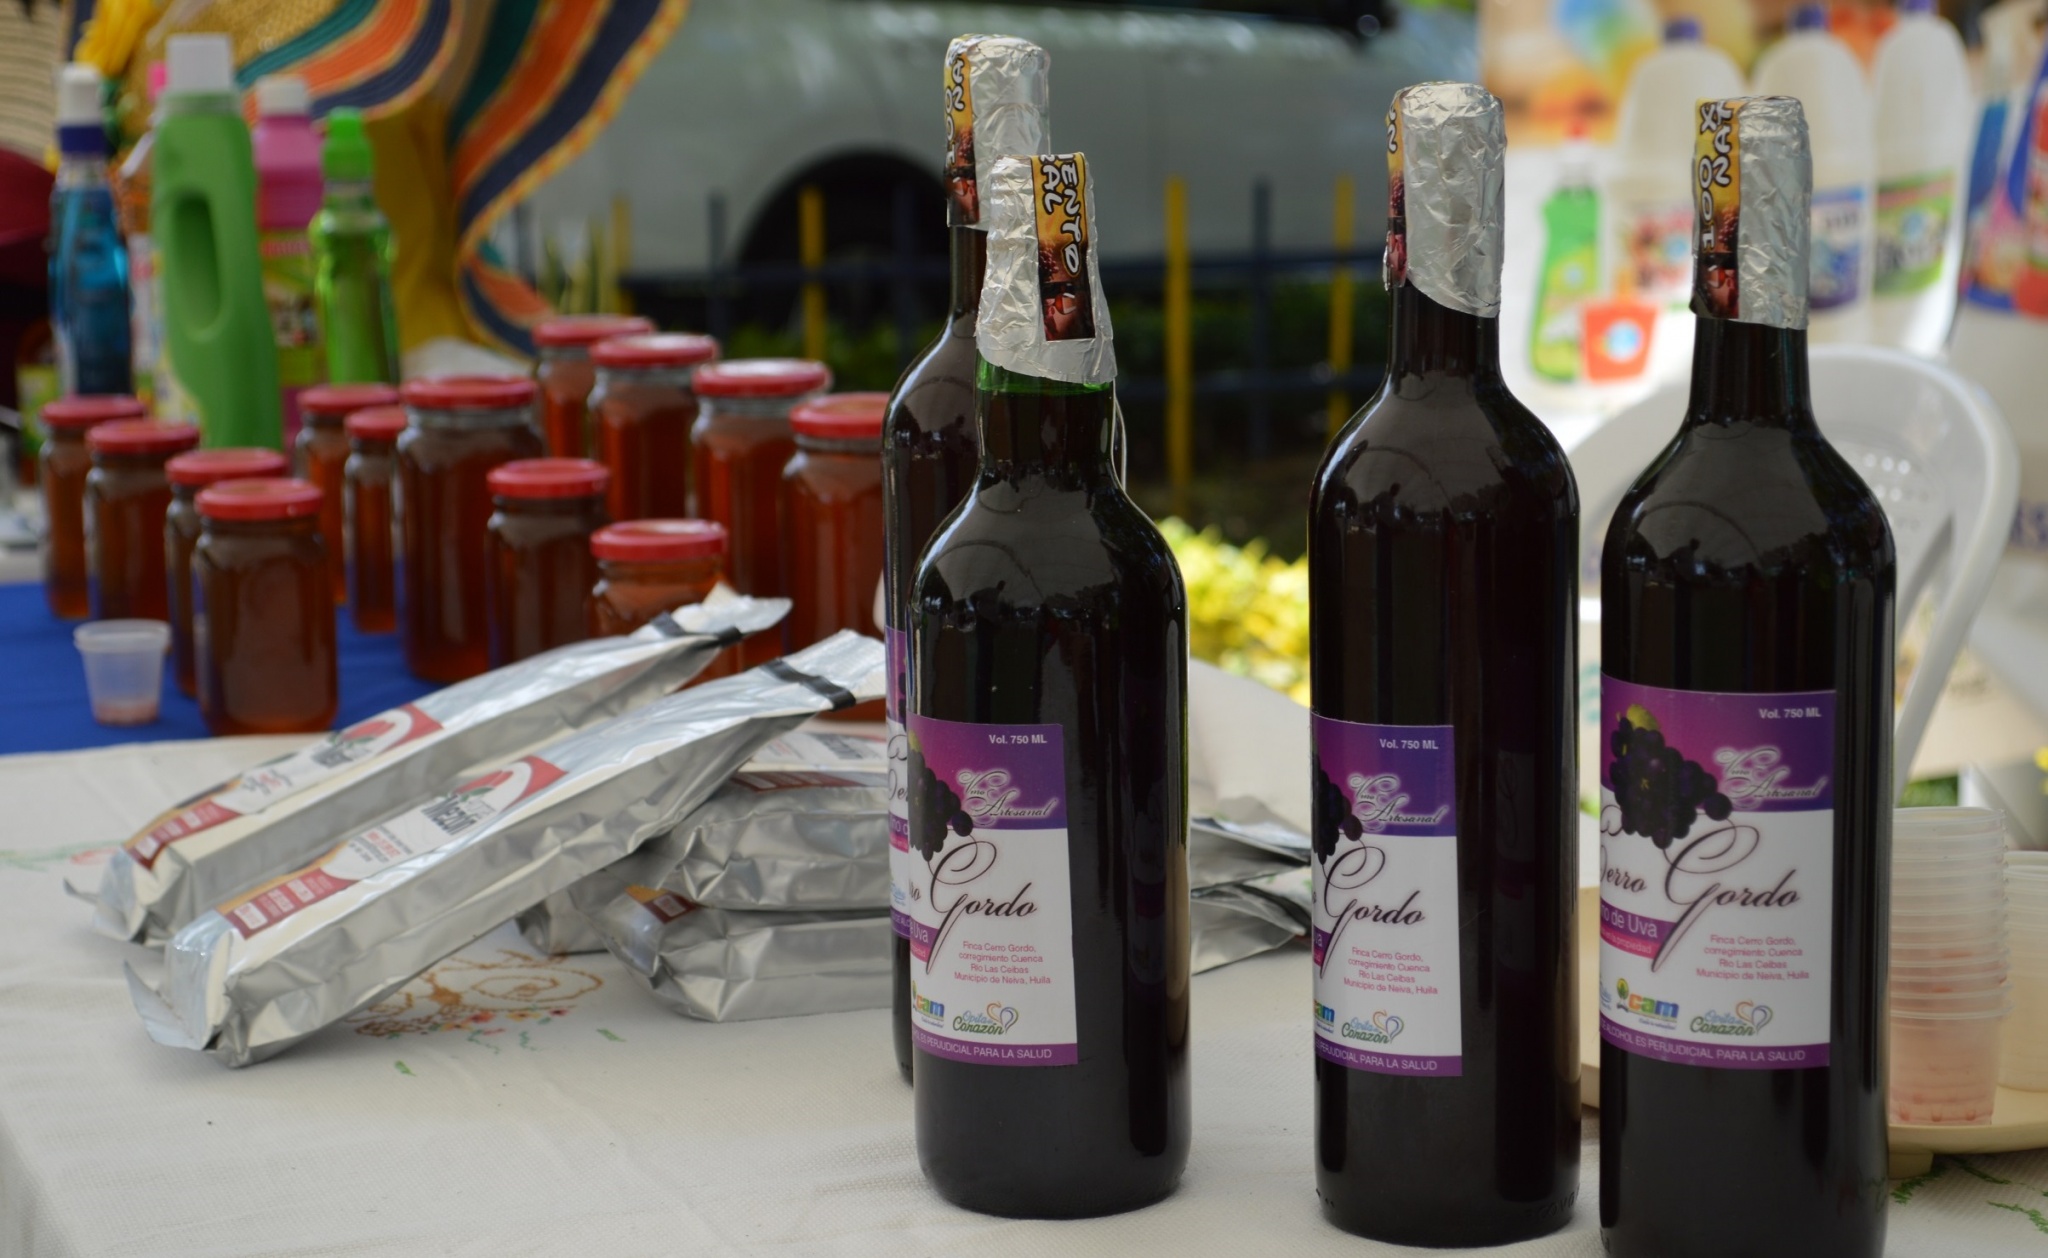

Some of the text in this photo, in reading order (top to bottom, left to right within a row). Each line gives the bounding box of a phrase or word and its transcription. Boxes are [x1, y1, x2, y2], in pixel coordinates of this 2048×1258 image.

[1057, 152, 1082, 276] IENTO
[1758, 707, 1822, 719] Vol. 750 ML
[989, 734, 1047, 744] Vol. 750 ML
[1379, 738, 1439, 750] Vol. 750 ML
[1720, 766, 1829, 808] Artesanal
[965, 789, 1058, 826] Artesanal
[1355, 794, 1449, 831] Artesanal
[912, 922, 929, 943] Uva
[1610, 910, 1625, 929] de
[1627, 914, 1658, 940] Uva
[963, 940, 983, 951] Finca
[984, 943, 1006, 952] Cerro
[1710, 934, 1735, 946] Finca
[1737, 936, 1763, 946] Cerro
[958, 951, 1043, 964] corregimiento Cuenca
[1352, 946, 1370, 958] Finca
[1372, 950, 1393, 960] Cerro
[1704, 946, 1803, 958] corregimiento Cuenca
[984, 965, 999, 974] Las
[1000, 966, 1029, 974] Ceibas
[1348, 958, 1430, 972] corregimiento Cuenca
[1736, 960, 1753, 969] Las
[1755, 960, 1787, 969] Ceibas
[954, 971, 988, 984] Municipio
[989, 975, 1000, 984] de
[1030, 976, 1051, 984] Huila
[1372, 972, 1385, 981] Las
[1387, 973, 1415, 983] Ceibas
[1696, 968, 1740, 980] Municipio
[1741, 971, 1755, 980] de
[1787, 971, 1810, 980] Huila
[1343, 977, 1375, 991] Municipio
[1376, 984, 1386, 992] de
[1415, 986, 1438, 994] Huila
[1628, 993, 1679, 1018] cam
[952, 1016, 1004, 1035] Corazón
[1341, 1022, 1390, 1044] Corazón
[1690, 1016, 1755, 1036] Corazón
[926, 1036, 972, 1056] PERJUDICIAL
[973, 1047, 999, 1058] PARA
[1001, 1049, 1014, 1059] LA
[1017, 1049, 1052, 1059] SALUD
[1606, 1023, 1634, 1044] ALCOHOL
[1635, 1036, 1647, 1048] ES
[1648, 1039, 1713, 1060] PERJUDICIAL
[1716, 1049, 1747, 1061] PARA
[1750, 1051, 1765, 1061] LA
[1767, 1050, 1806, 1062] SALUD
[1359, 1055, 1384, 1068] PARA
[1386, 1058, 1399, 1069] LA
[1401, 1058, 1438, 1071] SALUD
